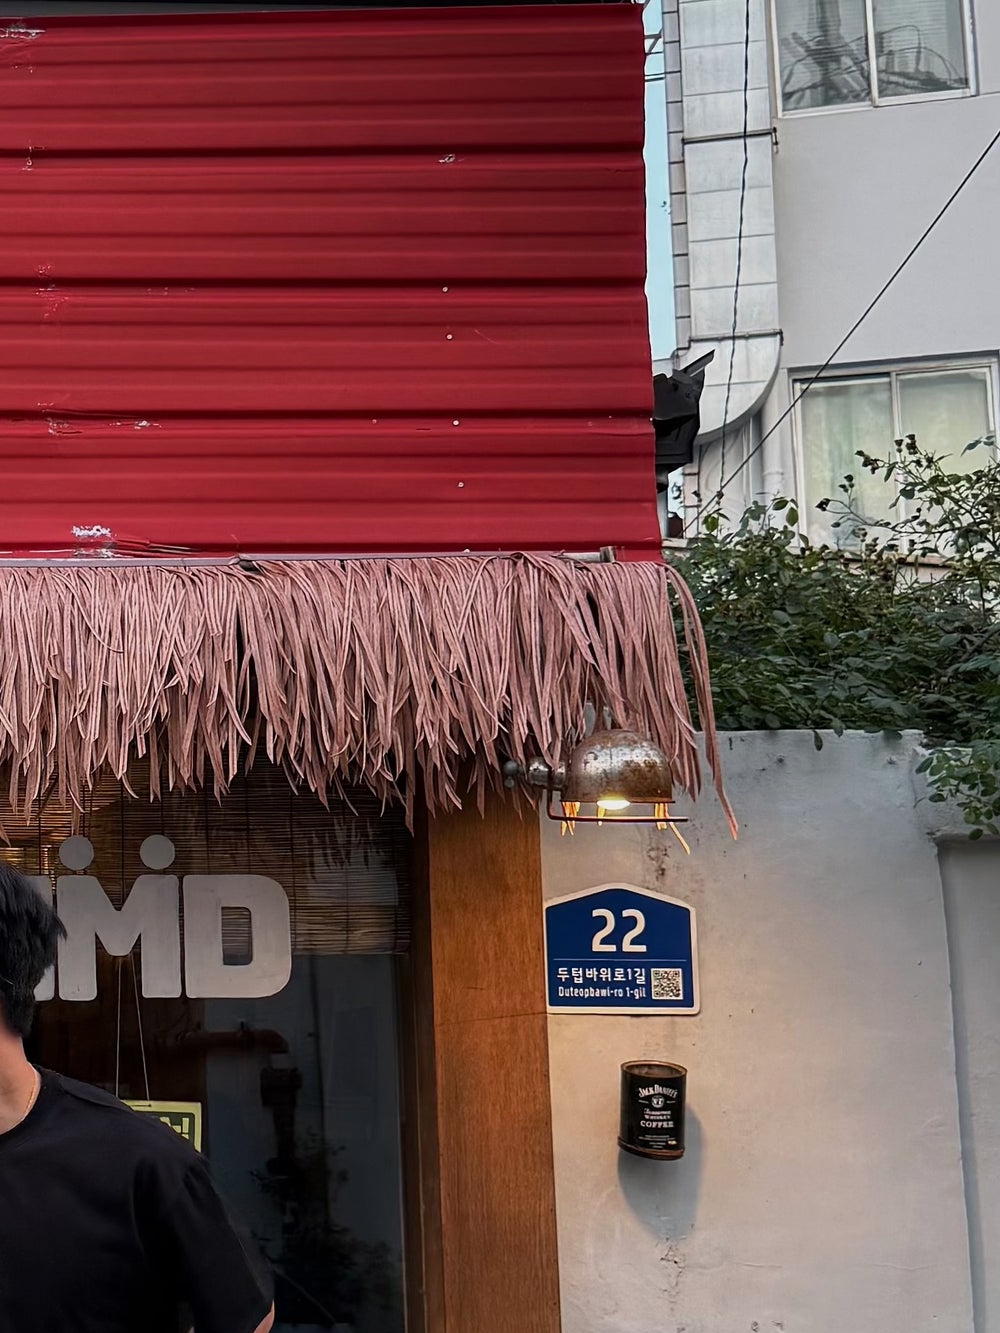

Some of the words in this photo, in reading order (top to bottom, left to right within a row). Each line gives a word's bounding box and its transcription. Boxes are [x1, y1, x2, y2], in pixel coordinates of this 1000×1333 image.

[591, 908, 647, 953] 22
[556, 967, 646, 985] 두텁바위로1길
[558, 986, 623, 998] Duteopbawi-ro
[626, 987, 646, 999] 1-gil
[640, 1120, 674, 1128] COFFEE
